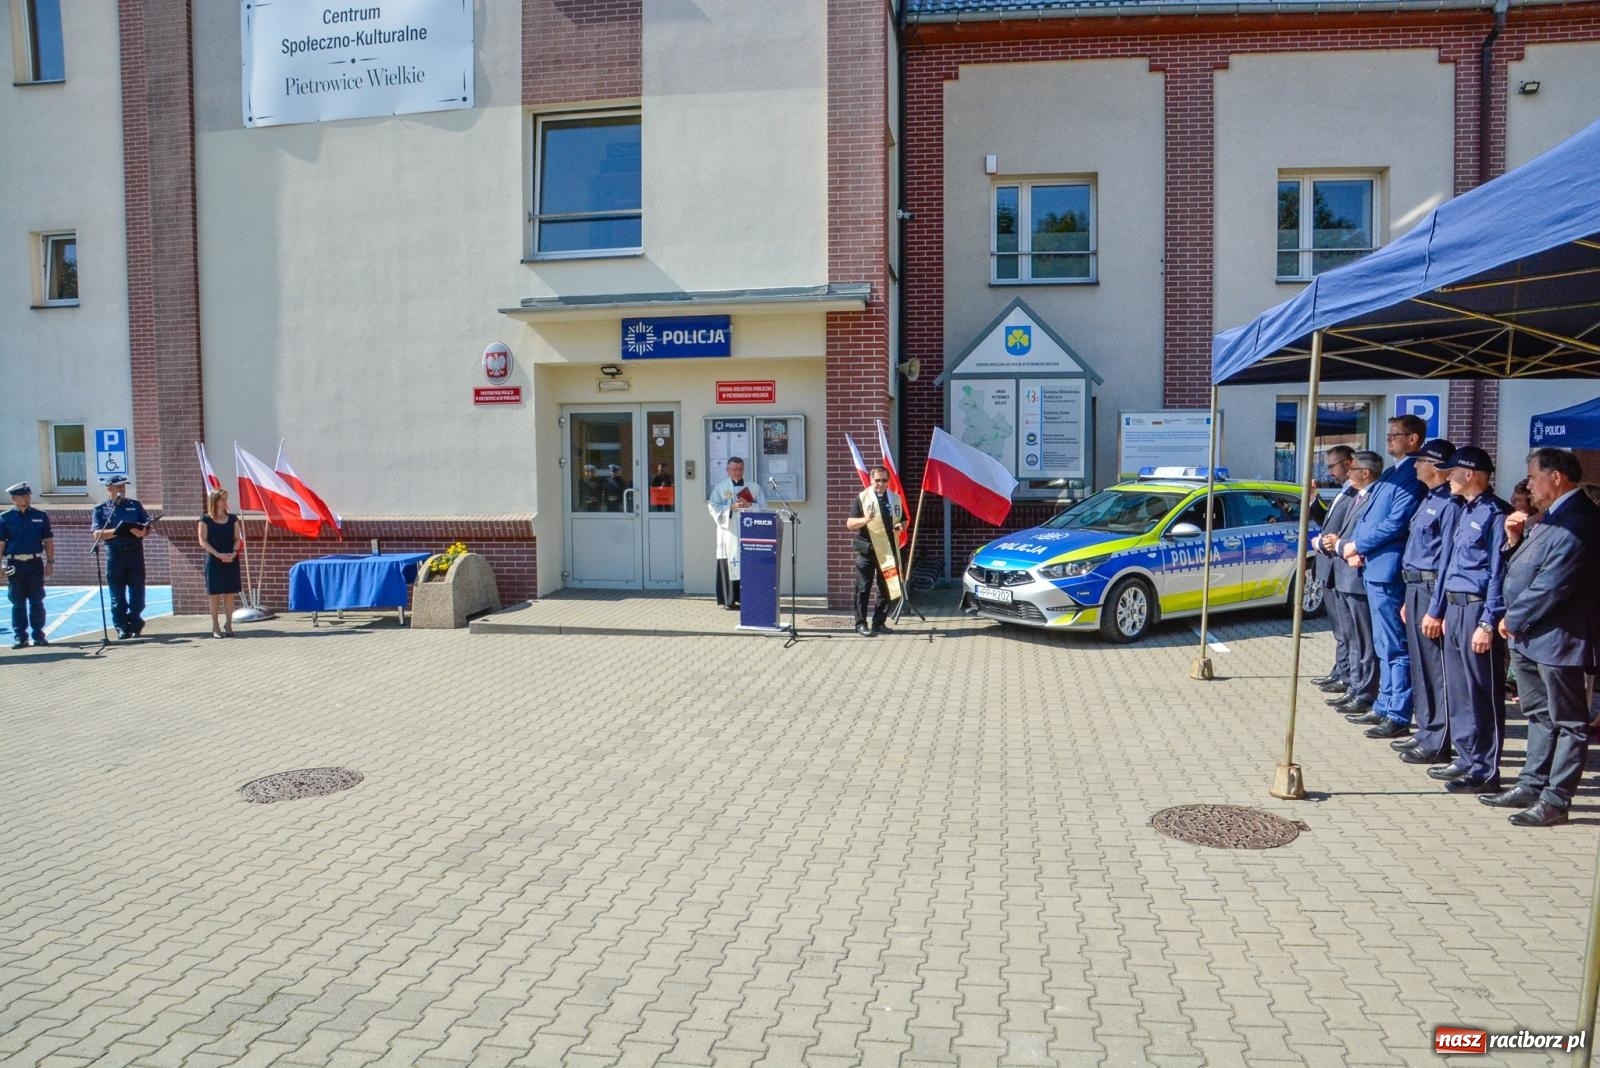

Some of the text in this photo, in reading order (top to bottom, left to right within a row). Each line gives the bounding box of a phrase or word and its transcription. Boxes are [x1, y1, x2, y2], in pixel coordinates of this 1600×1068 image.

[322, 6, 381, 25] Centrum
[281, 25, 428, 57] Społeczno-Kulturalne
[285, 65, 426, 96] Pietrowice Wielkie
[662, 329, 725, 345] POLICJA
[1544, 425, 1566, 436] POLICJA
[103, 430, 119, 451] P
[1427, 450, 1442, 458] POLICJA
[993, 542, 1048, 555] POLICJA
